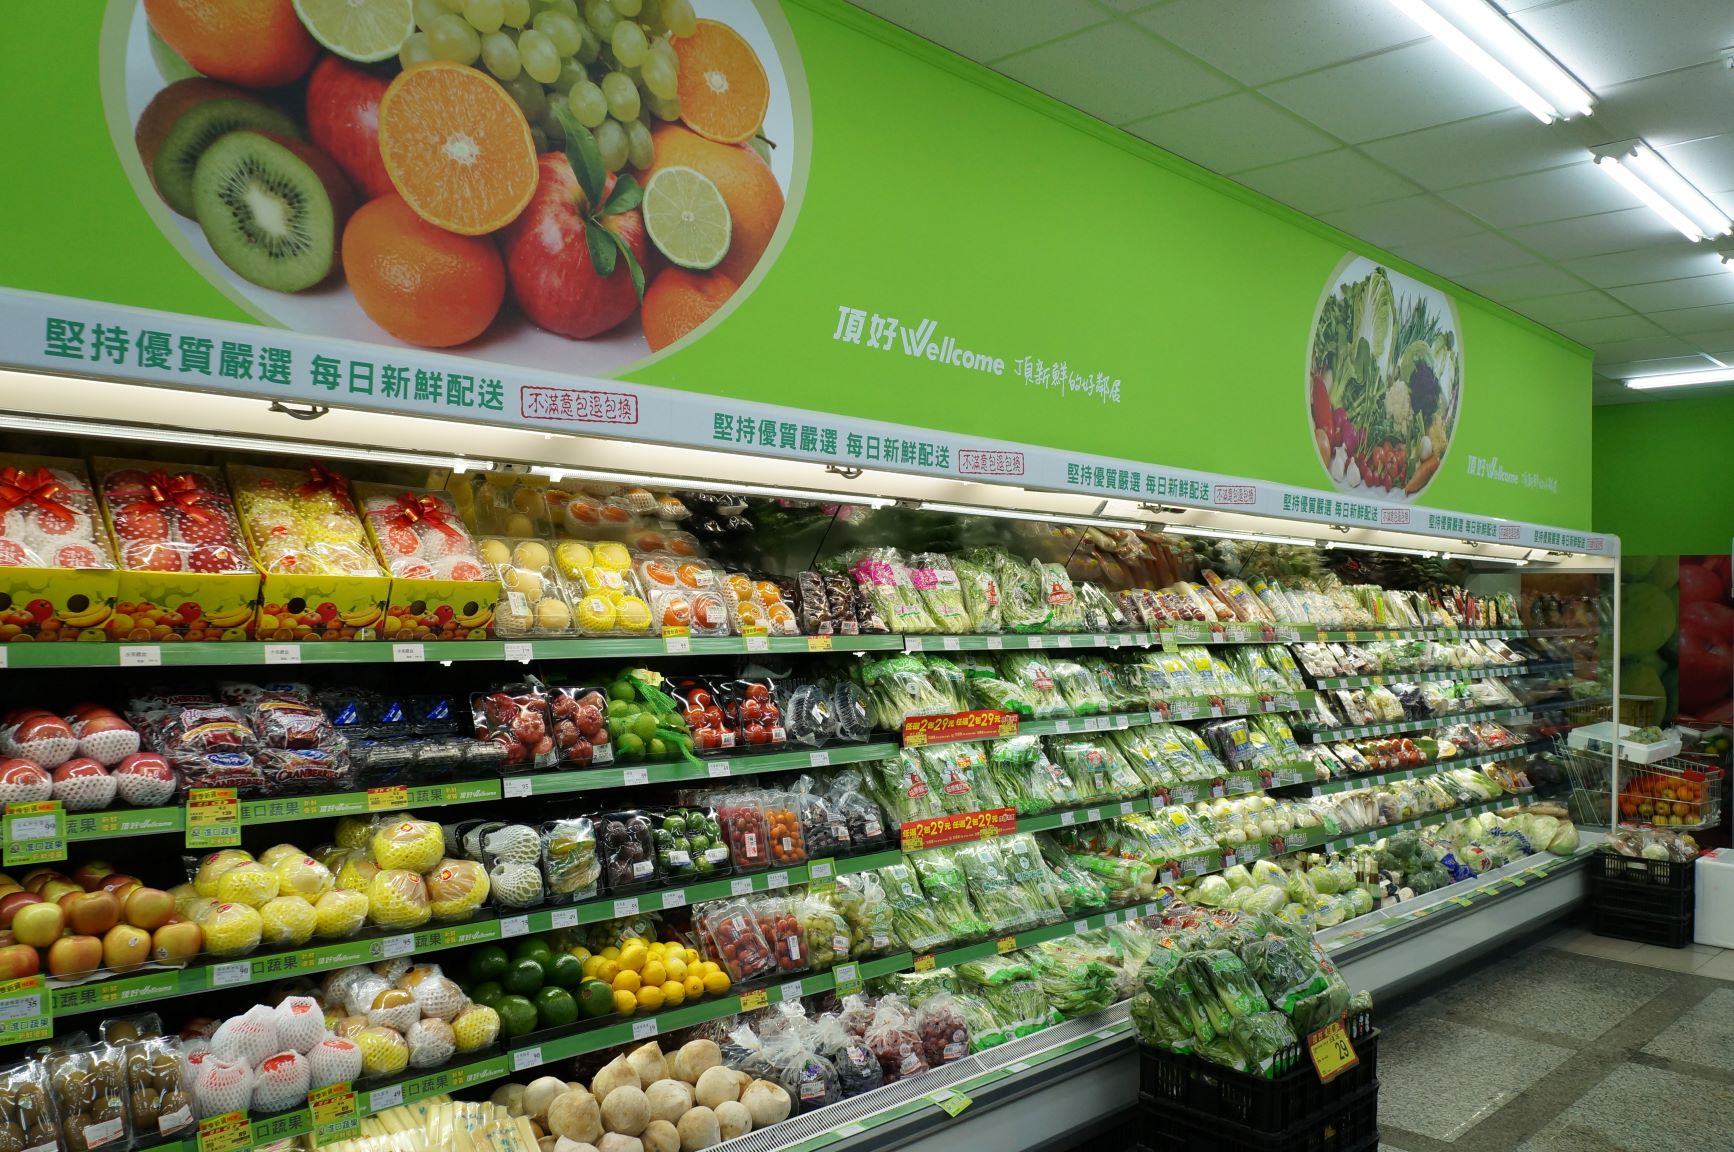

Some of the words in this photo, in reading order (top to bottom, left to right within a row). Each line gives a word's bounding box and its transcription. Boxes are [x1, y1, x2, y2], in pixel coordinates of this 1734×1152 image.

[43, 316, 292, 386] 堅持優質嚴選
[310, 354, 504, 411] 每日新鮮配送
[833, 306, 898, 350] 頂好
[900, 318, 1005, 376] Wellcome
[1014, 355, 1122, 405] 頂新鮮的好鄰居
[528, 393, 632, 420] 不滿意包退包換
[713, 412, 837, 456] 堅持優質嚴選
[846, 431, 950, 469] 每日新鮮配送
[1067, 463, 1141, 493] 堅持優質嚴選
[1146, 474, 1210, 501] 每日新鮮配送
[1334, 1040, 1349, 1060] 29
